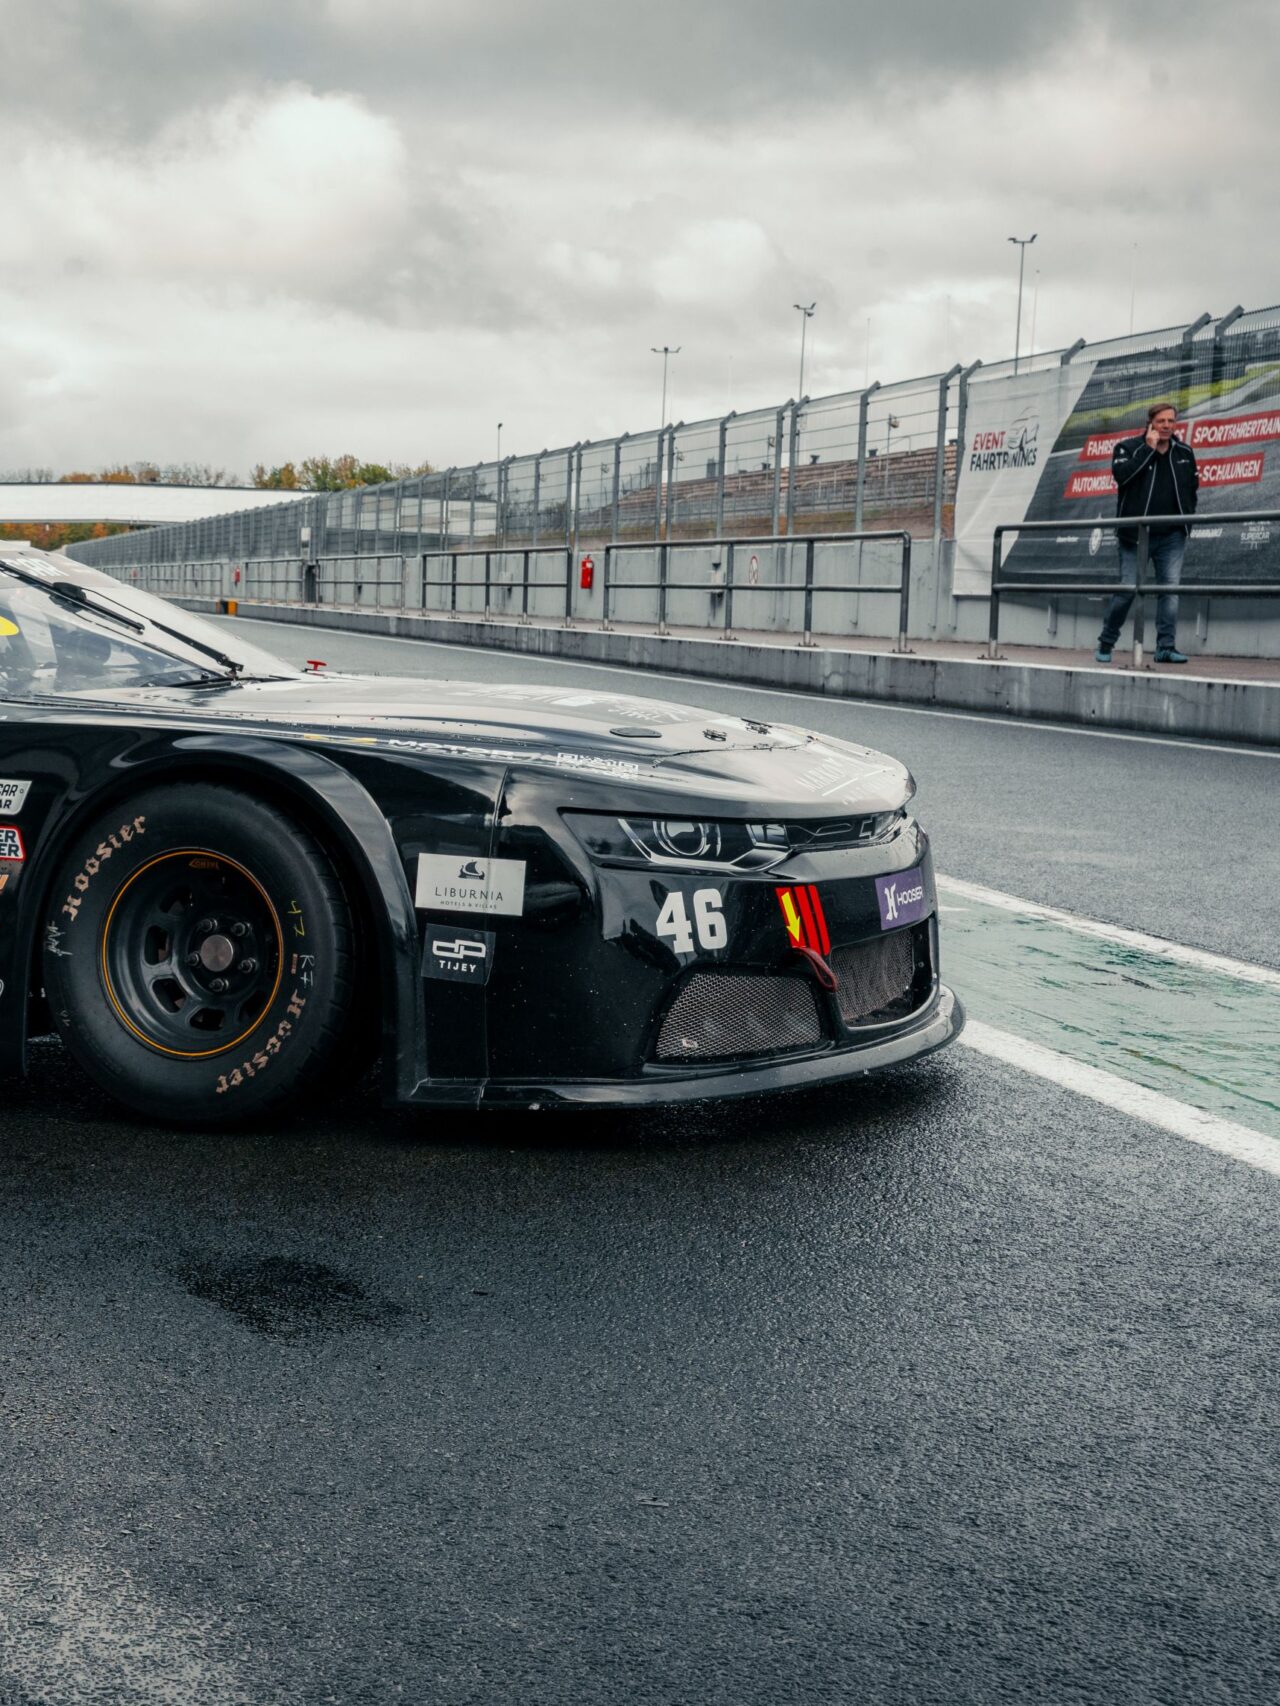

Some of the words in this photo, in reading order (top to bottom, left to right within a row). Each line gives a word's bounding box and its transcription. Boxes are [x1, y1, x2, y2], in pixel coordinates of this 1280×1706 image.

[973, 431, 1007, 451] EVENT
[62, 816, 146, 922] Hoosier
[435, 887, 503, 901] LIBURNIA
[288, 901, 305, 937] 47
[656, 888, 728, 954] 46
[440, 960, 477, 973] TIJEY
[216, 989, 307, 1094] Hoosier
